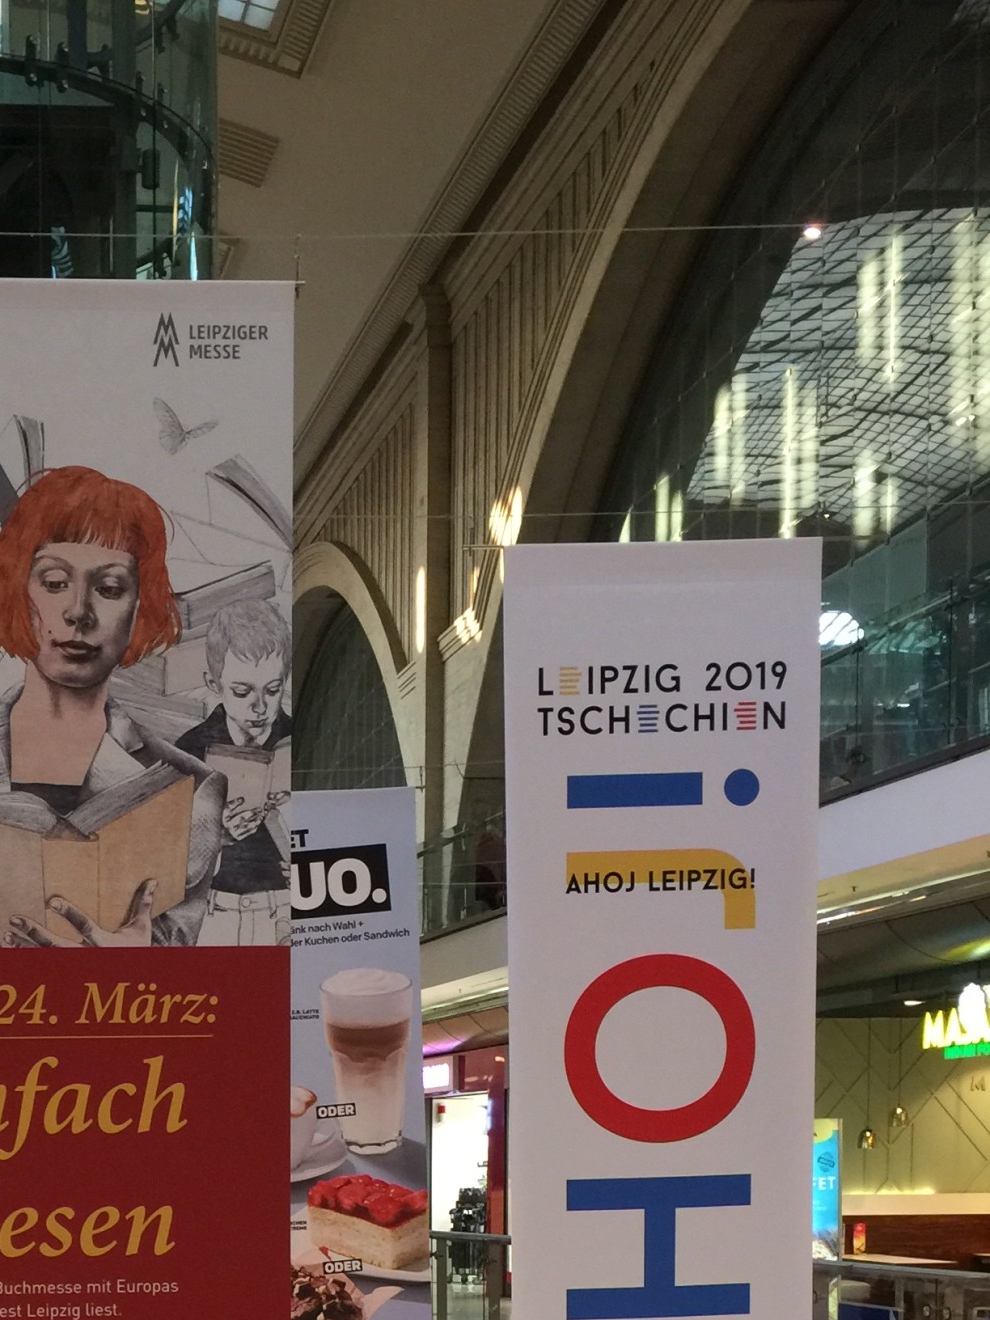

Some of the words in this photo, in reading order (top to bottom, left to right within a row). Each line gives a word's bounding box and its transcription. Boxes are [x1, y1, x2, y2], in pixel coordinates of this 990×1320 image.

[188, 323, 269, 342] LEIPZIGER
[188, 343, 241, 361] MESSE
[538, 663, 681, 696] LEIPZIG
[705, 660, 788, 692] 2019
[537, 700, 786, 736] TSCHECHIEN
[565, 869, 636, 895] AHOJ
[647, 867, 757, 893] LEIPZIG!
[307, 922, 332, 933] nach
[332, 920, 357, 931] Wahl
[304, 935, 340, 947] Kuchen
[341, 932, 363, 943] oder
[363, 928, 411, 941] Sandwich
[75, 981, 218, 1025] März:
[317, 1104, 355, 1118] ODER
[323, 1260, 362, 1274] ODER
[86, 1279, 112, 1295] mit
[116, 1279, 179, 1296] Europas
[26, 1303, 81, 1320] Leipzig
[85, 1303, 123, 1317] liest.
